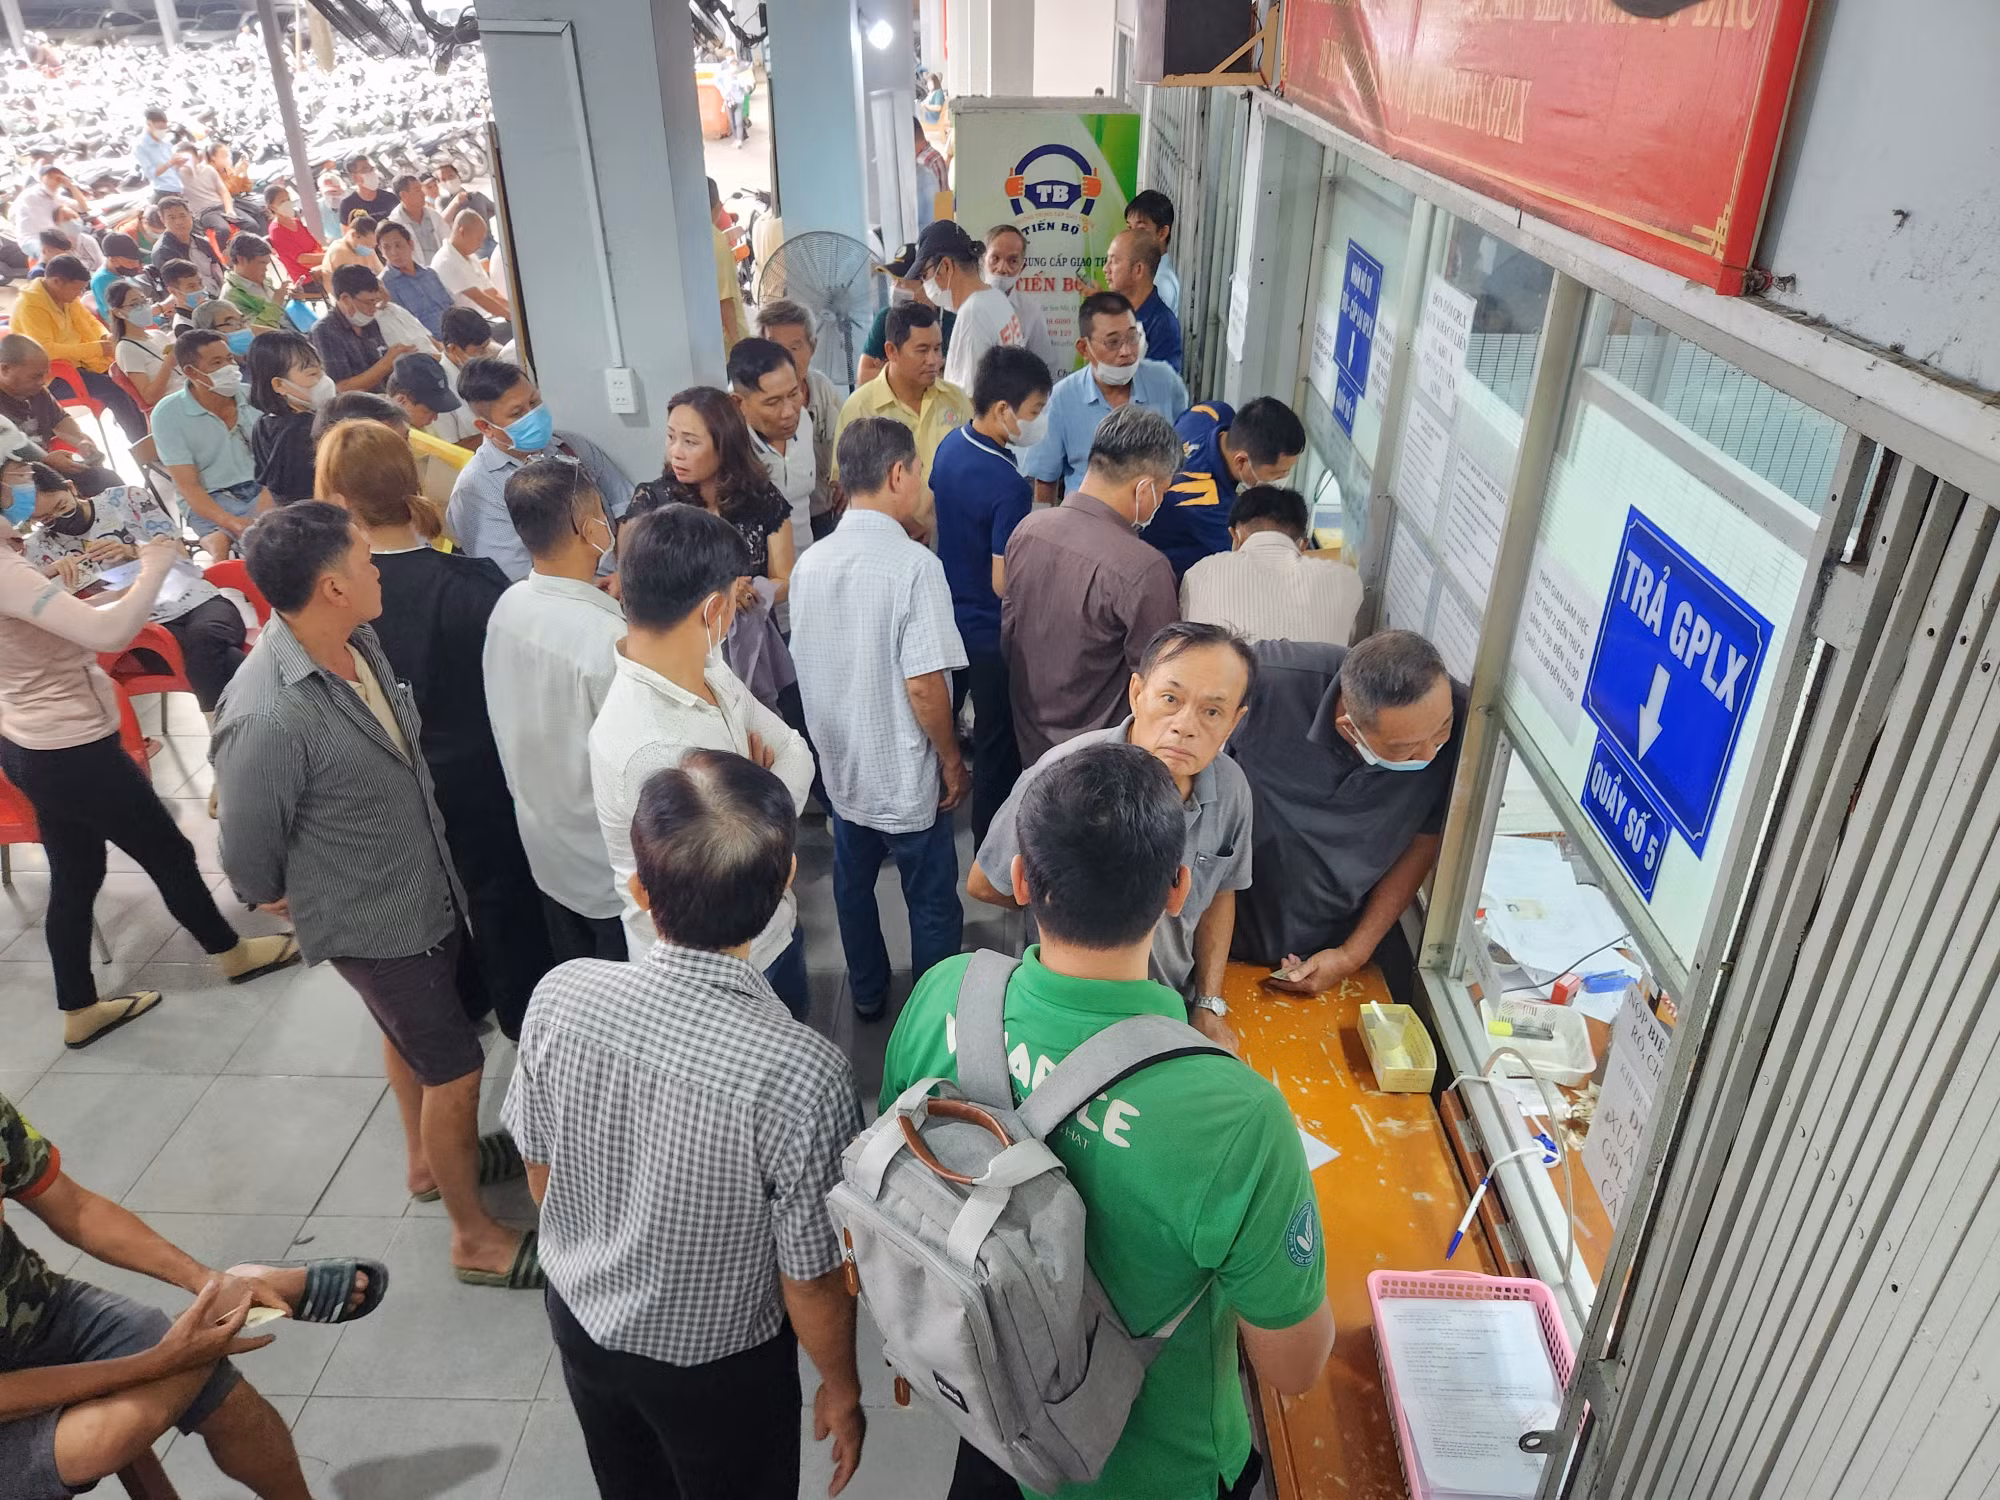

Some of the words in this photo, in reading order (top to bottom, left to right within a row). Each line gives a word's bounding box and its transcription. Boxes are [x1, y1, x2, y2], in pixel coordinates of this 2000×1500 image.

[1486, 74, 1533, 144] GPLX
[1036, 185, 1069, 203] TB
[1021, 219, 1055, 236] TIẾN
[1049, 253, 1068, 267] CẤP
[1070, 257, 1092, 267] GIAO
[1551, 584, 1564, 606] GIAN
[1577, 613, 1590, 637] VIỆC
[1555, 616, 1568, 640] ĐẾN
[1579, 648, 1585, 661] 6
[1619, 550, 1672, 639] TRẢ
[1669, 601, 1749, 713] GPLX
[1552, 641, 1565, 662] ĐẾN
[1549, 665, 1561, 685] ĐẾN
[1559, 678, 1574, 703] 17:00
[1623, 806, 1653, 850] SỐ
[1644, 834, 1659, 872] 5
[1647, 1024, 1667, 1060] BIÊ
[1646, 1054, 1662, 1083] CH
[1601, 1138, 1628, 1194] GPL
